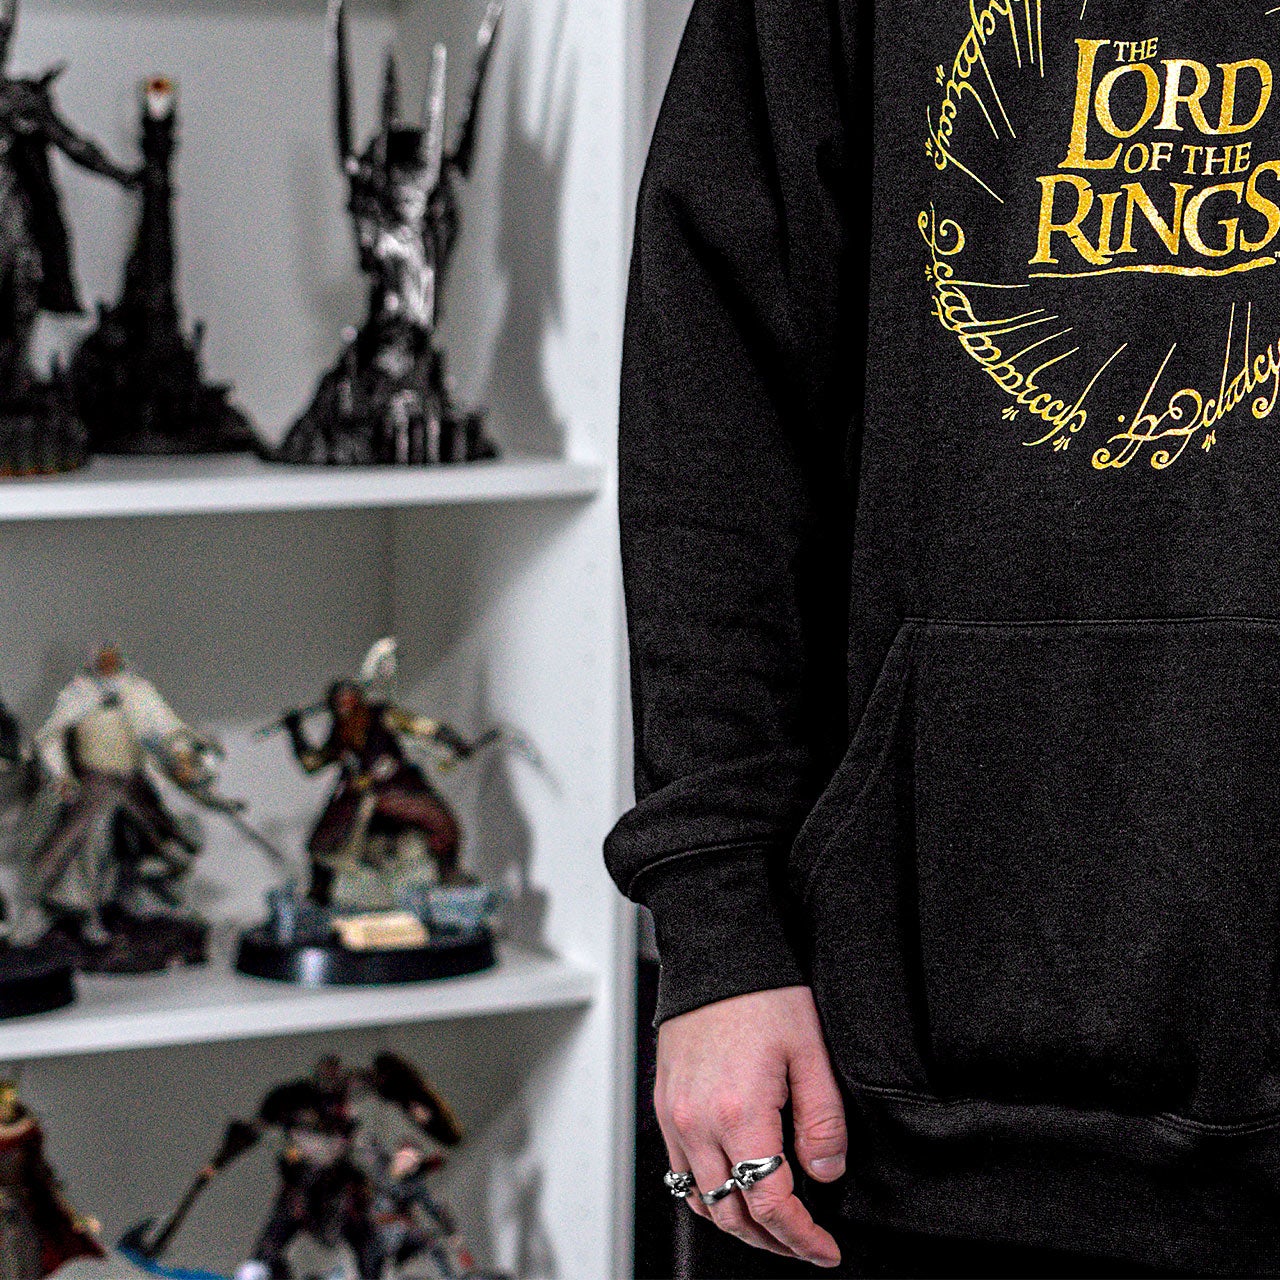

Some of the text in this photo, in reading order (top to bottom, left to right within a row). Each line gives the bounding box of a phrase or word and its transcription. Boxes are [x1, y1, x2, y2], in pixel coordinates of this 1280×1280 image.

[1113, 37, 1158, 62] THE
[1057, 38, 1273, 170] LORD
[1123, 142, 1252, 175] OF THE
